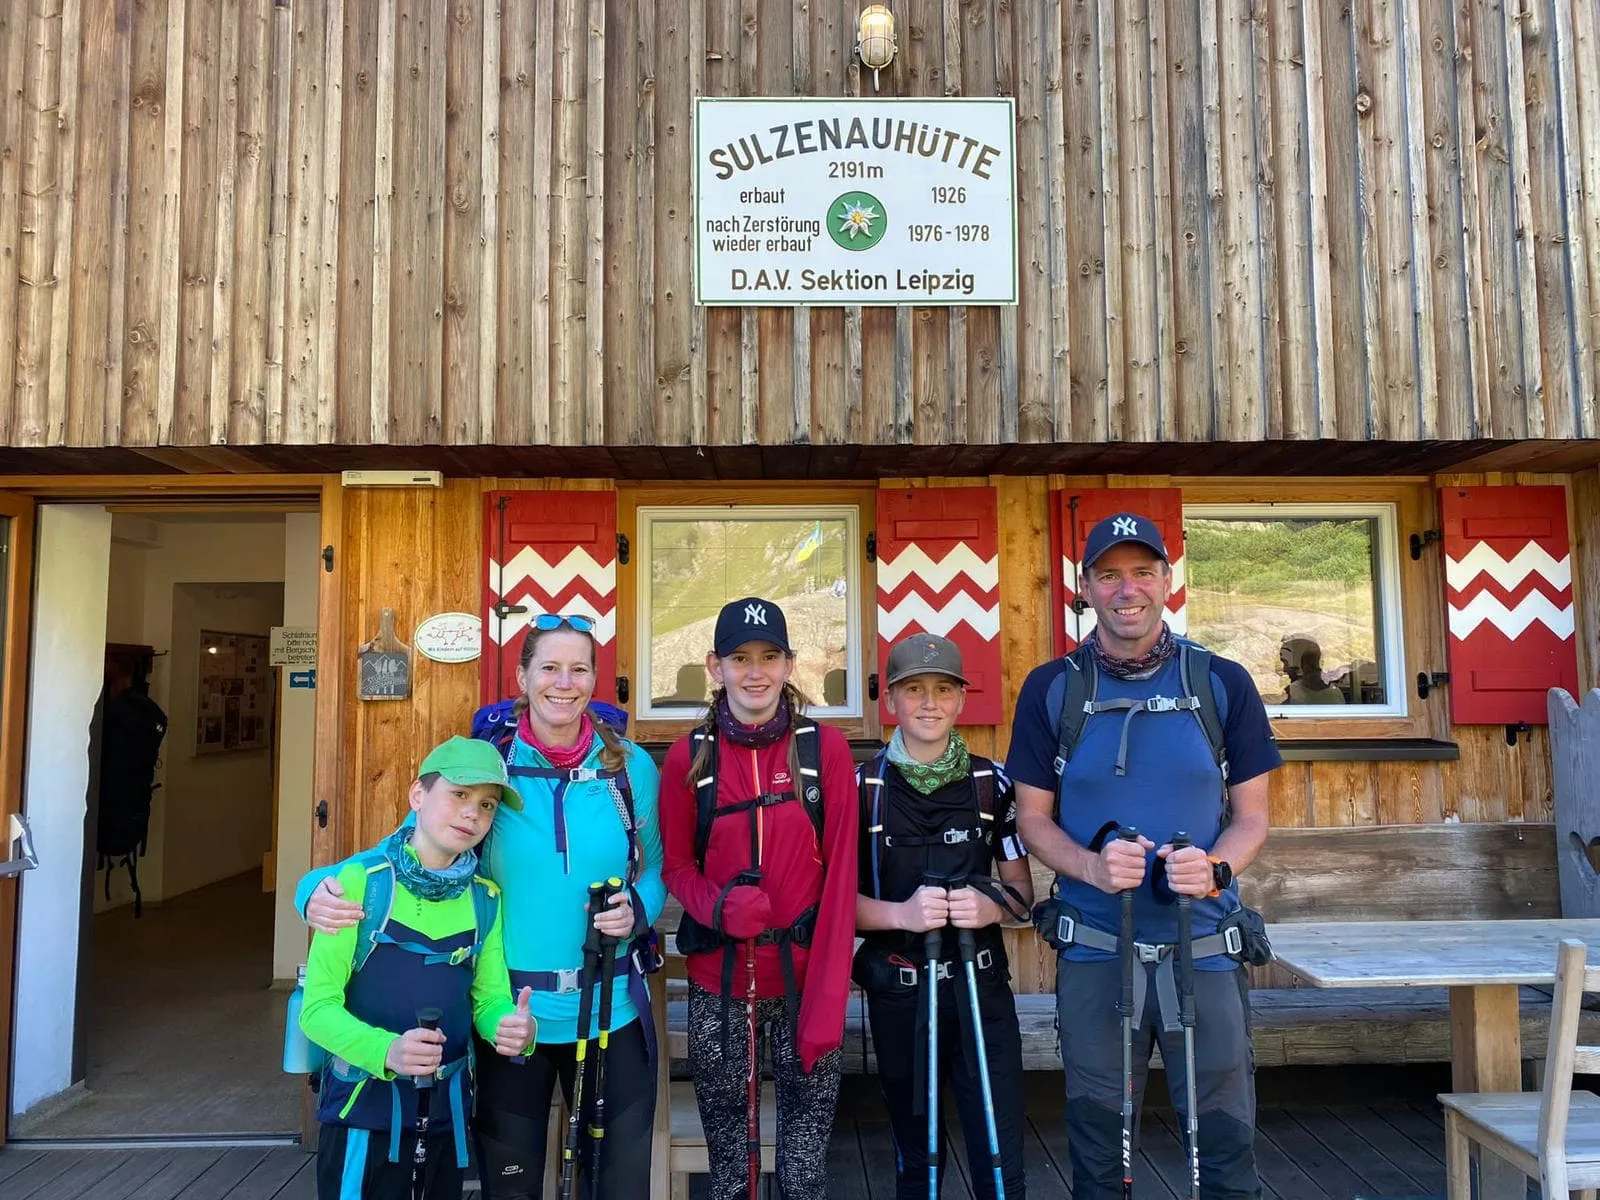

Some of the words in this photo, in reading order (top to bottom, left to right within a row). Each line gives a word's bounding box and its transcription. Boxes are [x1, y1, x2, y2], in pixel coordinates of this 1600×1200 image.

[709, 117, 1001, 181] SULZENAUHÜTTE
[739, 187, 786, 204] erbaut
[931, 187, 967, 204] 1926
[706, 216, 740, 233] nach
[742, 215, 820, 238] Zerstörung
[712, 235, 760, 252] wieder
[765, 237, 812, 252] erbaut
[731, 268, 792, 291] D.A.V.
[801, 268, 888, 291] Sektion
[896, 268, 975, 296] Leipzig
[1111, 517, 1138, 536] NY
[743, 603, 768, 626] NY
[1122, 1127, 1130, 1168] LEKI
